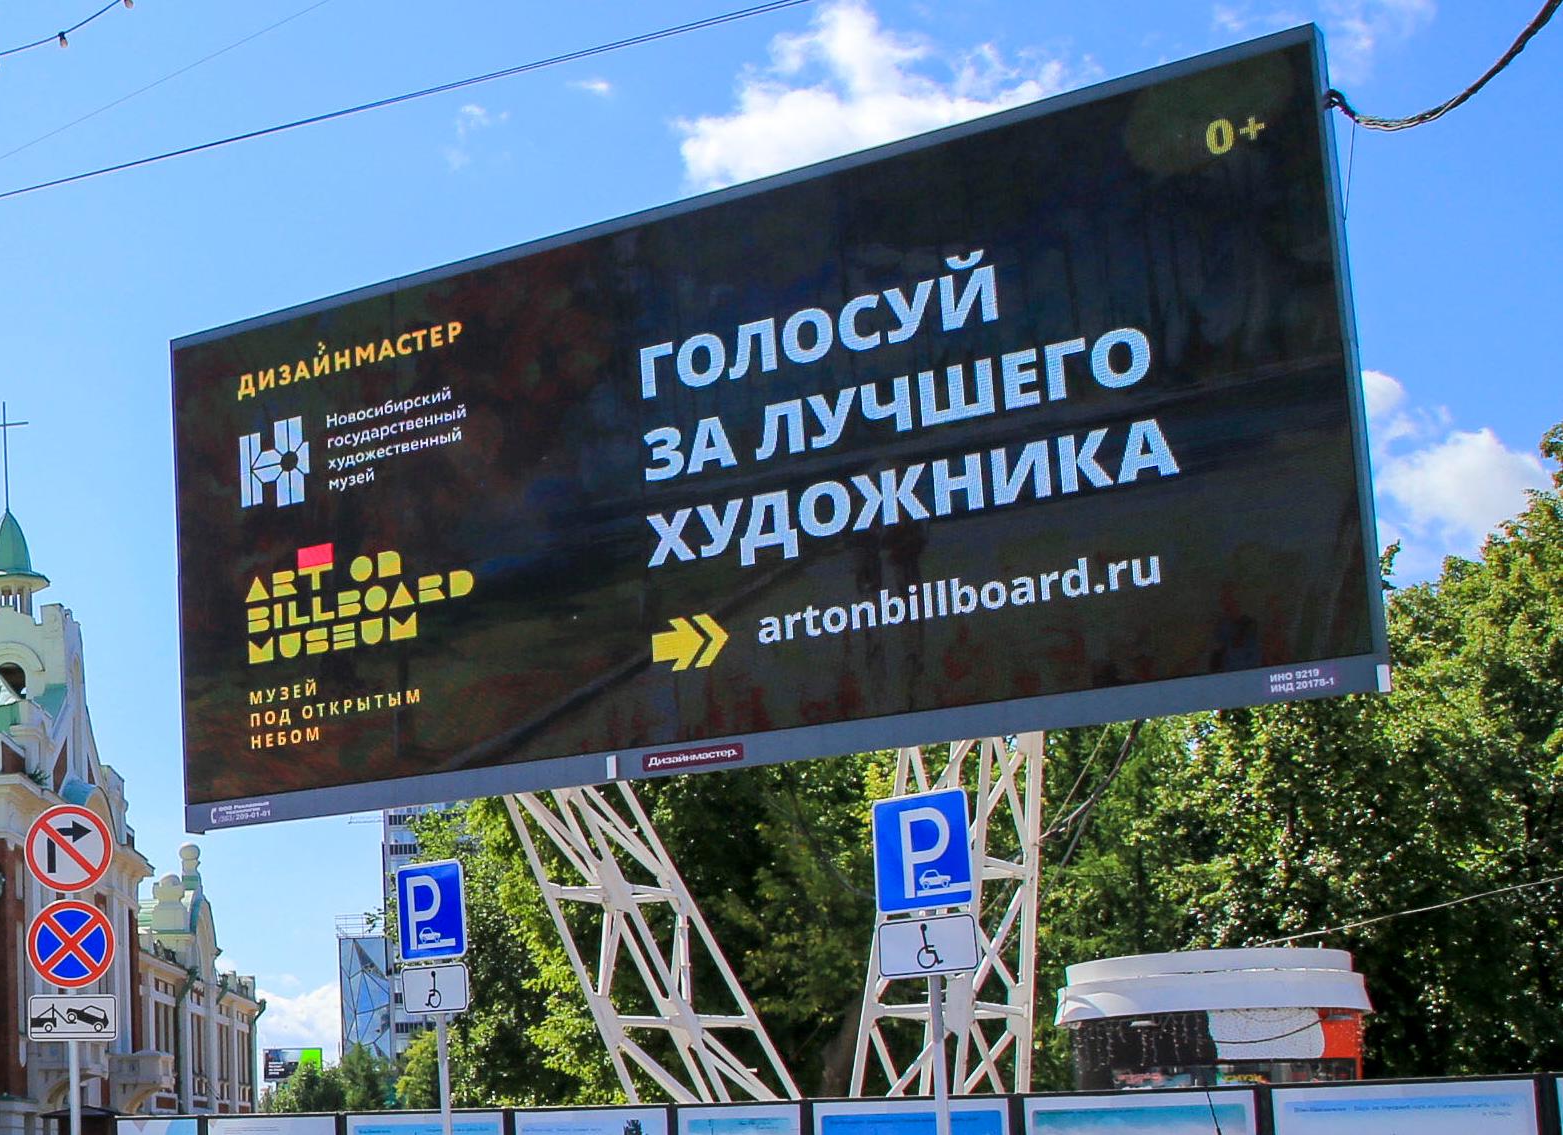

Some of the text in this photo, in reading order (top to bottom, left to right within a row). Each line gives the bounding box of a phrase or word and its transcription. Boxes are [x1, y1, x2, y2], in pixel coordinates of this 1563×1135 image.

[1205, 115, 1266, 155] 0+
[639, 249, 999, 399] ГОЛОСУЙ
[237, 321, 463, 401] ДИЗАЙНМАСТЕР
[326, 385, 452, 429] Новосибирский
[326, 403, 468, 449] государственный
[643, 327, 1153, 482] ЗА ЛУЧШЕГО
[327, 426, 463, 472] художественный
[328, 467, 376, 492] музей
[645, 418, 1181, 569] ХУДОЖНИКА
[245, 560, 334, 603] ART
[247, 569, 475, 634] BILLBOARD
[756, 554, 1162, 645] artonbillboard.ru
[248, 611, 418, 665] MUSEUM
[249, 678, 317, 706] МУЗЕЙ
[250, 688, 421, 728] ПОД ОТКРЫТЫМ
[250, 726, 320, 750] НЕБОМ
